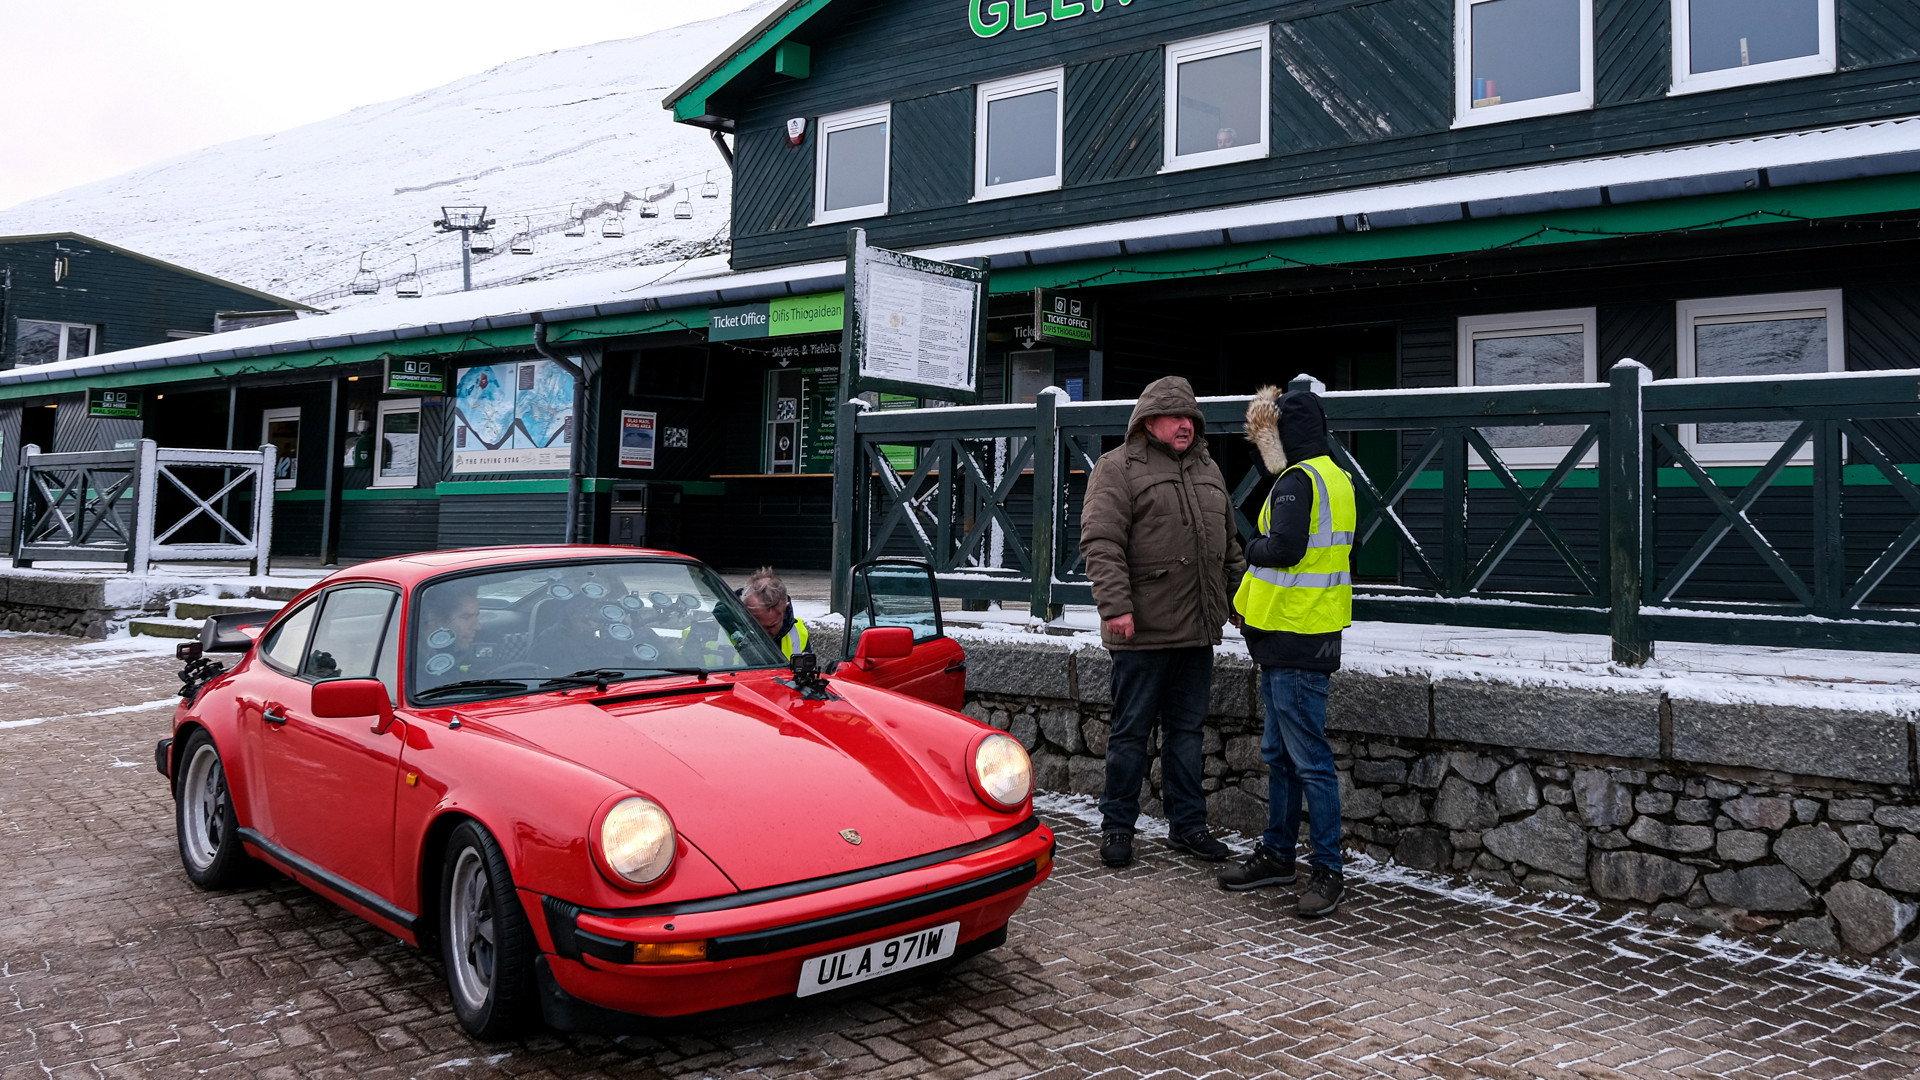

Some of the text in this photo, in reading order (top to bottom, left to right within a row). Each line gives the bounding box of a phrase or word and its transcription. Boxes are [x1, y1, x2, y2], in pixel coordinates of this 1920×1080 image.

[713, 311, 766, 329] Ticket Office
[771, 305, 842, 323] Oifis Thiogaidean
[1047, 314, 1088, 329] TICKET OFFICE
[504, 456, 520, 464] STAG
[1275, 494, 1296, 502] USTO
[817, 928, 944, 985] ULA 971W
